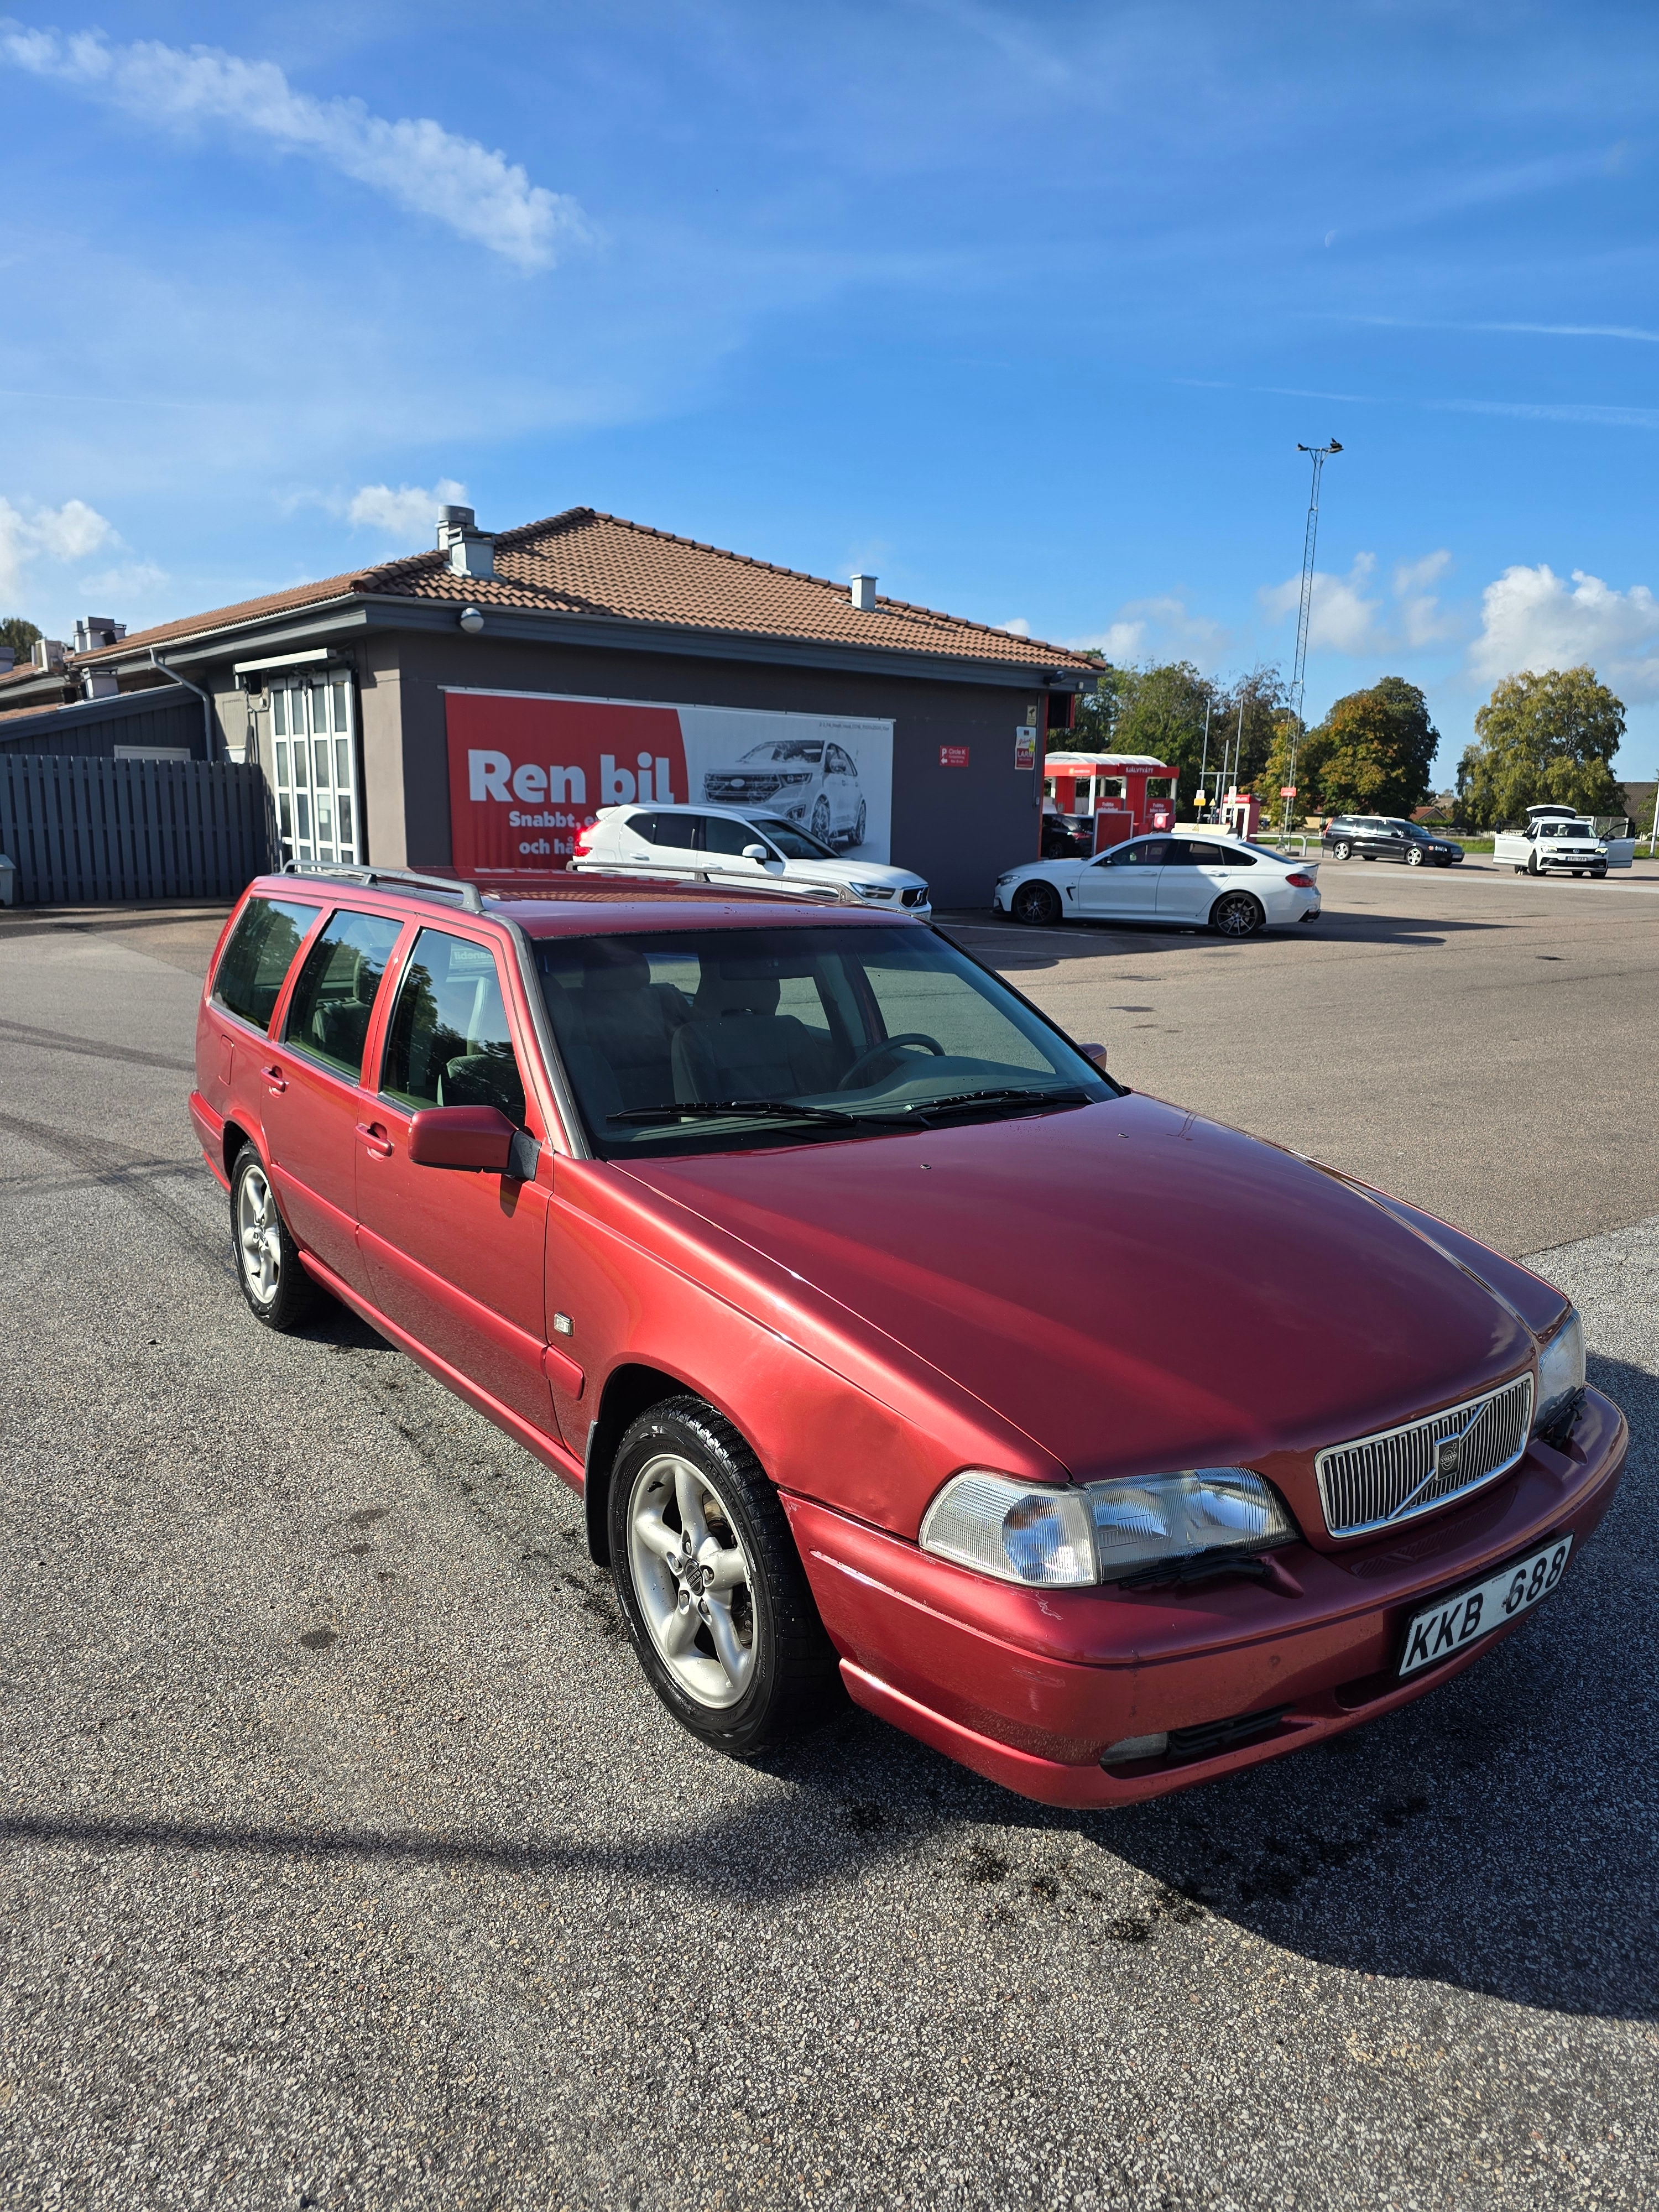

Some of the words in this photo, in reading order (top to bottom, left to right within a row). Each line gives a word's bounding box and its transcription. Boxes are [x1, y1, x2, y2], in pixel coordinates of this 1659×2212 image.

[468, 749, 586, 804] Ren
[600, 752, 674, 804] bil
[509, 811, 582, 830] Snabbt,
[519, 838, 550, 854] och
[1441, 1454, 1456, 1463] VOLVO
[688, 1571, 701, 1585] VOLVO
[1406, 1593, 1483, 1668] KKB
[1505, 1546, 1566, 1614] 688
